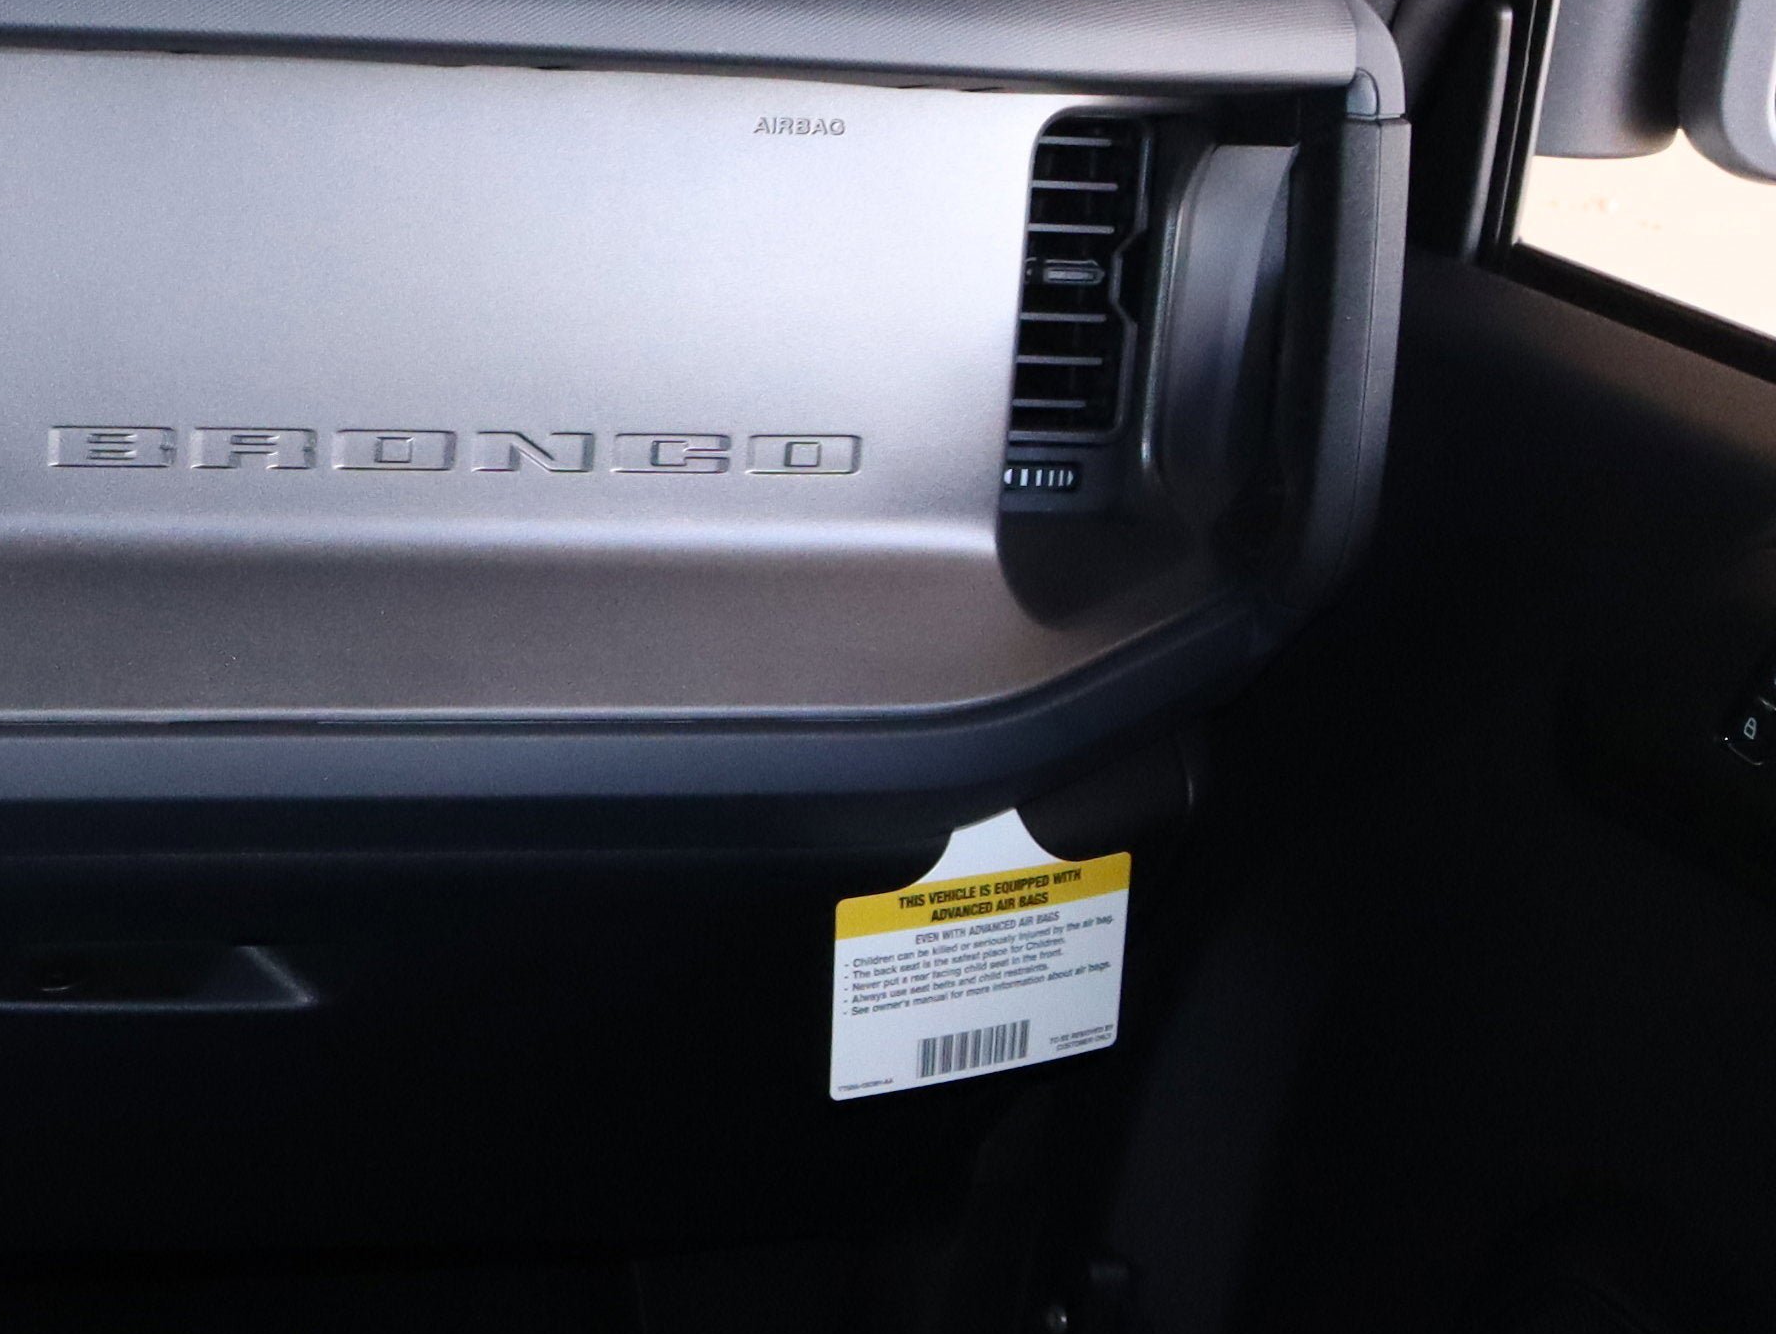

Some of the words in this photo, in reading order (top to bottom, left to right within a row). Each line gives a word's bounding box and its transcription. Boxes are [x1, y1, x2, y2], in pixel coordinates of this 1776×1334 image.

[752, 116, 846, 136] AIRBAG
[48, 425, 863, 474] BRONCO
[899, 892, 925, 910] THIS
[928, 886, 977, 905] VEHICLE
[979, 883, 992, 897] IS
[994, 874, 1050, 895] EQUIPPED
[1053, 868, 1082, 885] WITH
[930, 901, 993, 923] ADVANCED
[996, 898, 1016, 912] AIR
[1019, 891, 1049, 909] BAGS
[915, 931, 939, 945] EVEN
[942, 927, 966, 941] WITH
[968, 918, 1017, 937] ADVANCED
[1018, 915, 1034, 929] AIR
[1036, 911, 1060, 925] BAGS
